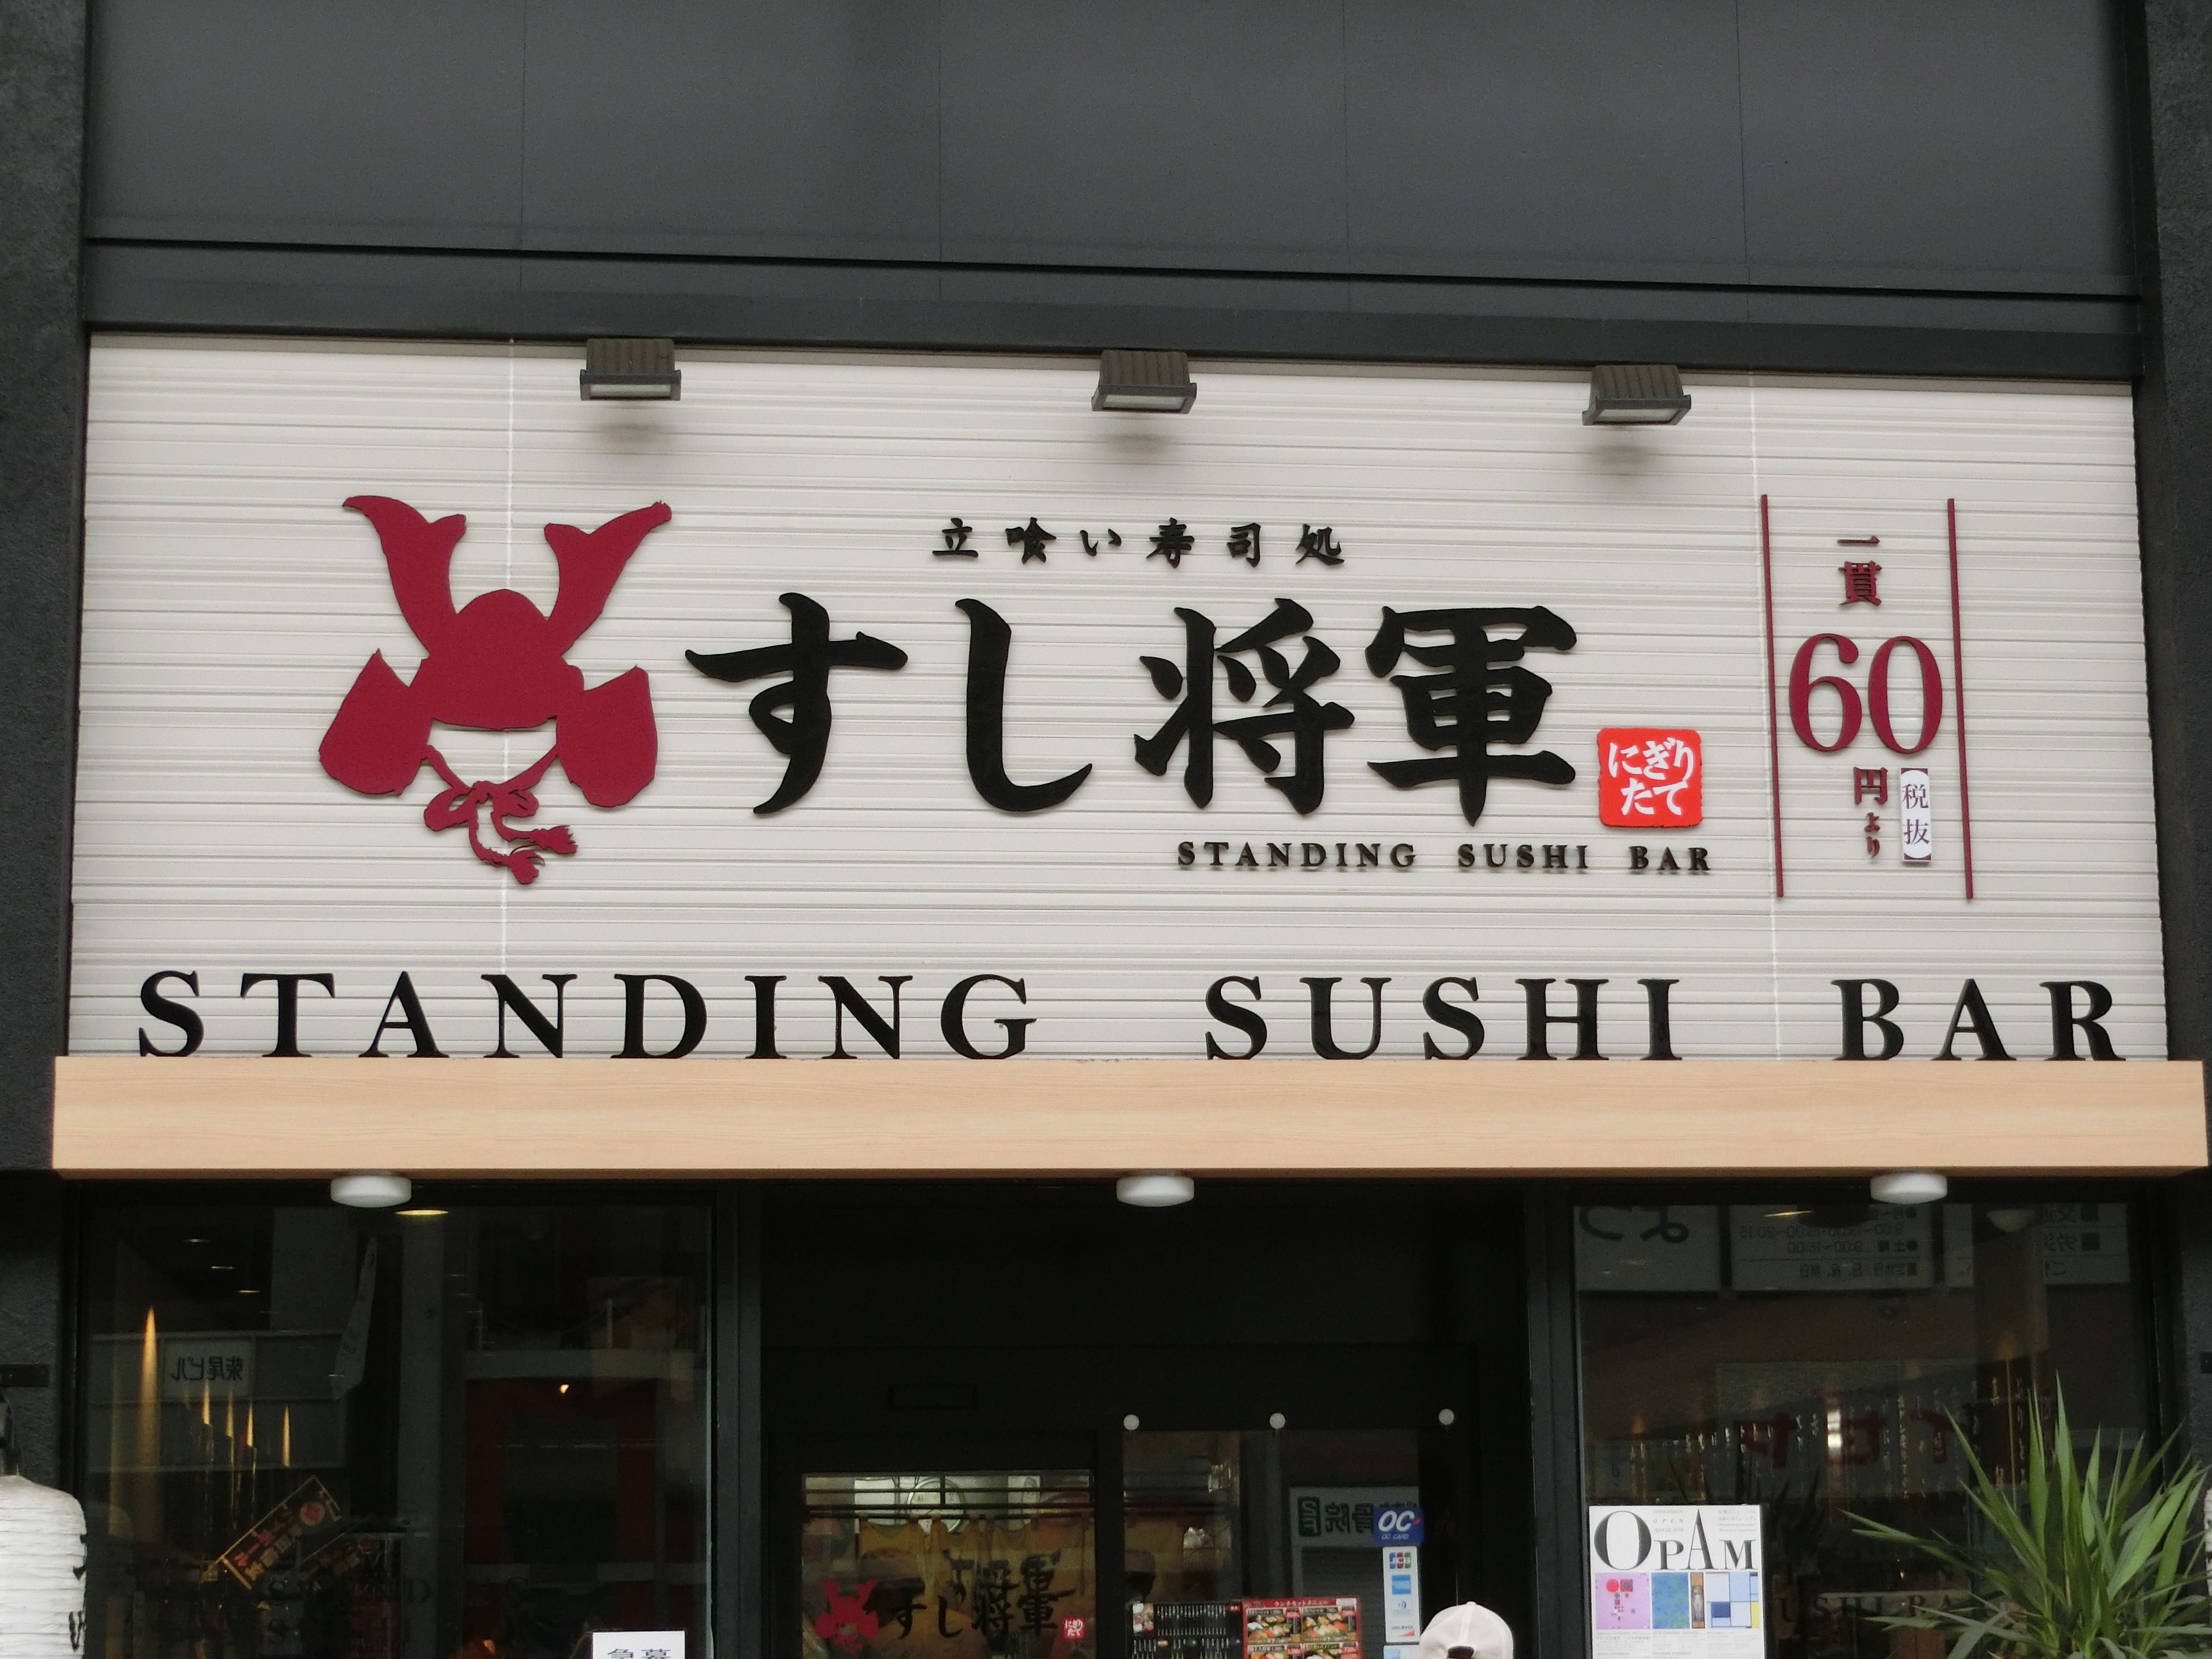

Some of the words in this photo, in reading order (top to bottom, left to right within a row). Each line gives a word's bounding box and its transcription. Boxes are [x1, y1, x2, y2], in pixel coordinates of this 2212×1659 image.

[932, 517, 1345, 568] 立喰い寿司処
[1837, 535, 1882, 606] 一貫
[685, 591, 1577, 827] すし将軍
[1788, 632, 1943, 754] 60
[1609, 737, 1696, 782] にぎり
[1621, 780, 1688, 816] たて
[1853, 767, 1888, 859] 円より
[1901, 783, 1930, 845] 税抜
[1177, 841, 1416, 868] STANDING
[1457, 843, 1589, 870] SUSHI
[1629, 846, 1711, 872] BAR
[138, 969, 1038, 1060] STANDING
[1204, 975, 1683, 1060] SUSHI
[1830, 978, 2128, 1061] BAR
[1378, 1510, 1415, 1532] OC
[1594, 1508, 1756, 1571] OPAM
